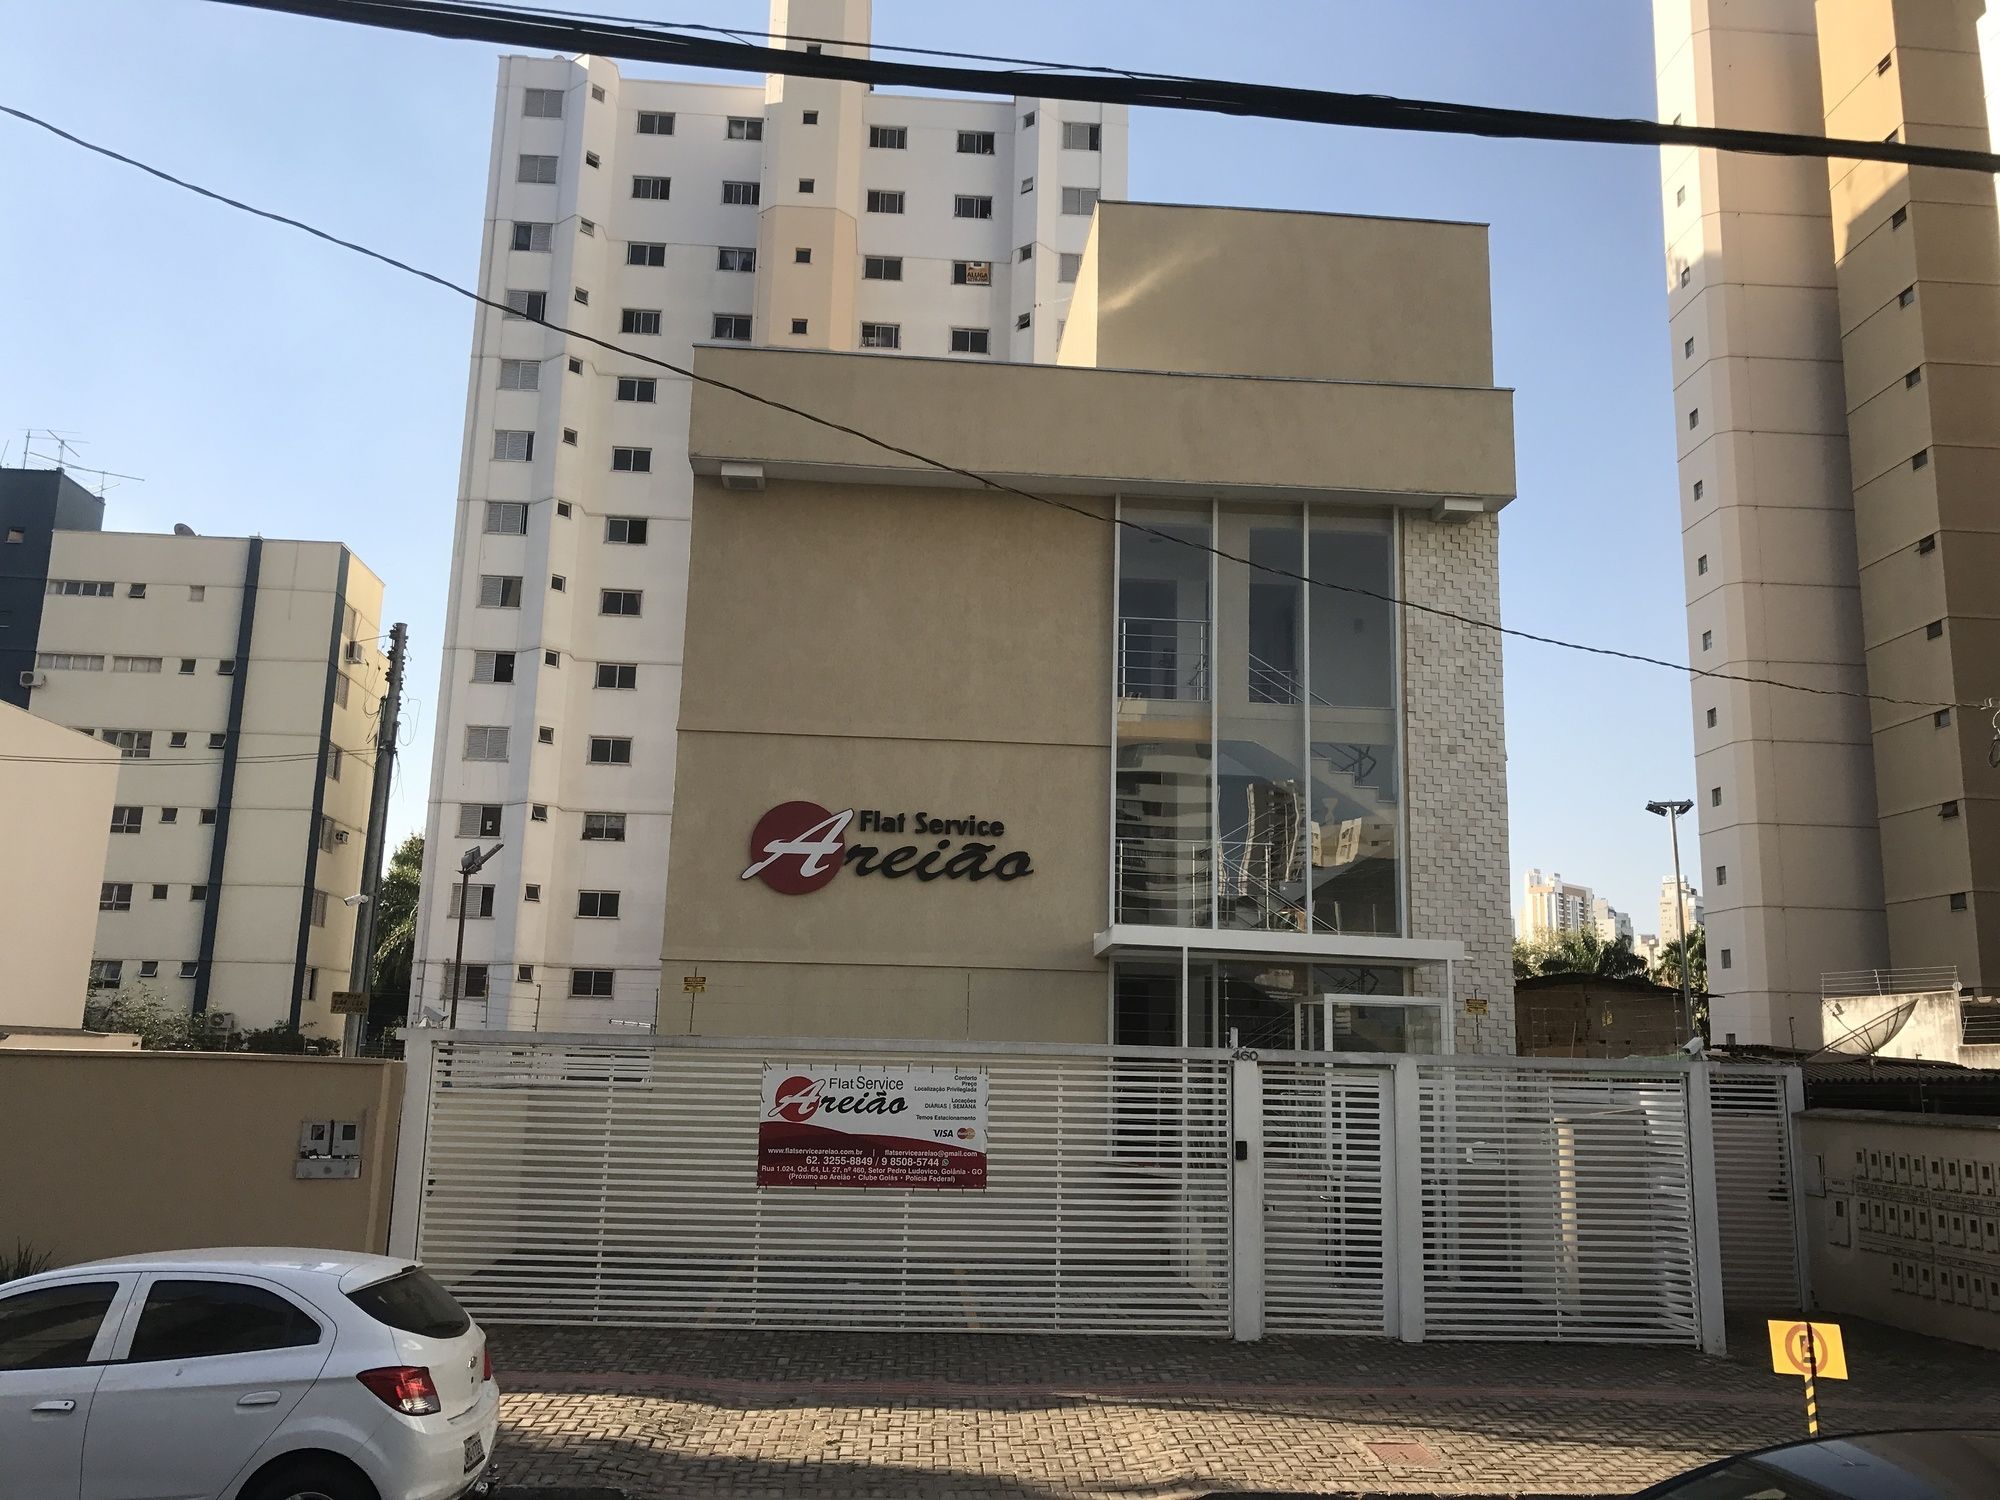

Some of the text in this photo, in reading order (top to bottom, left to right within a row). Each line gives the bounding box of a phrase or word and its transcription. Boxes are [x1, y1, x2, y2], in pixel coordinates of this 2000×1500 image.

[859, 810, 1005, 836] Flat Service
[1232, 1050, 1259, 1061] 460
[829, 1075, 904, 1091] Flat Service
[933, 1129, 954, 1138] VISA
[805, 1155, 821, 1165] 62.
[823, 1156, 873, 1166] 3255-8849
[881, 1157, 888, 1166] 9
[889, 1157, 940, 1167] 8508-5744
[852, 1167, 867, 1175] 460,
[908, 1168, 940, 1176] Ludovico,
[788, 1173, 818, 1181] (Próximo
[928, 1175, 956, 1183] Federal)
